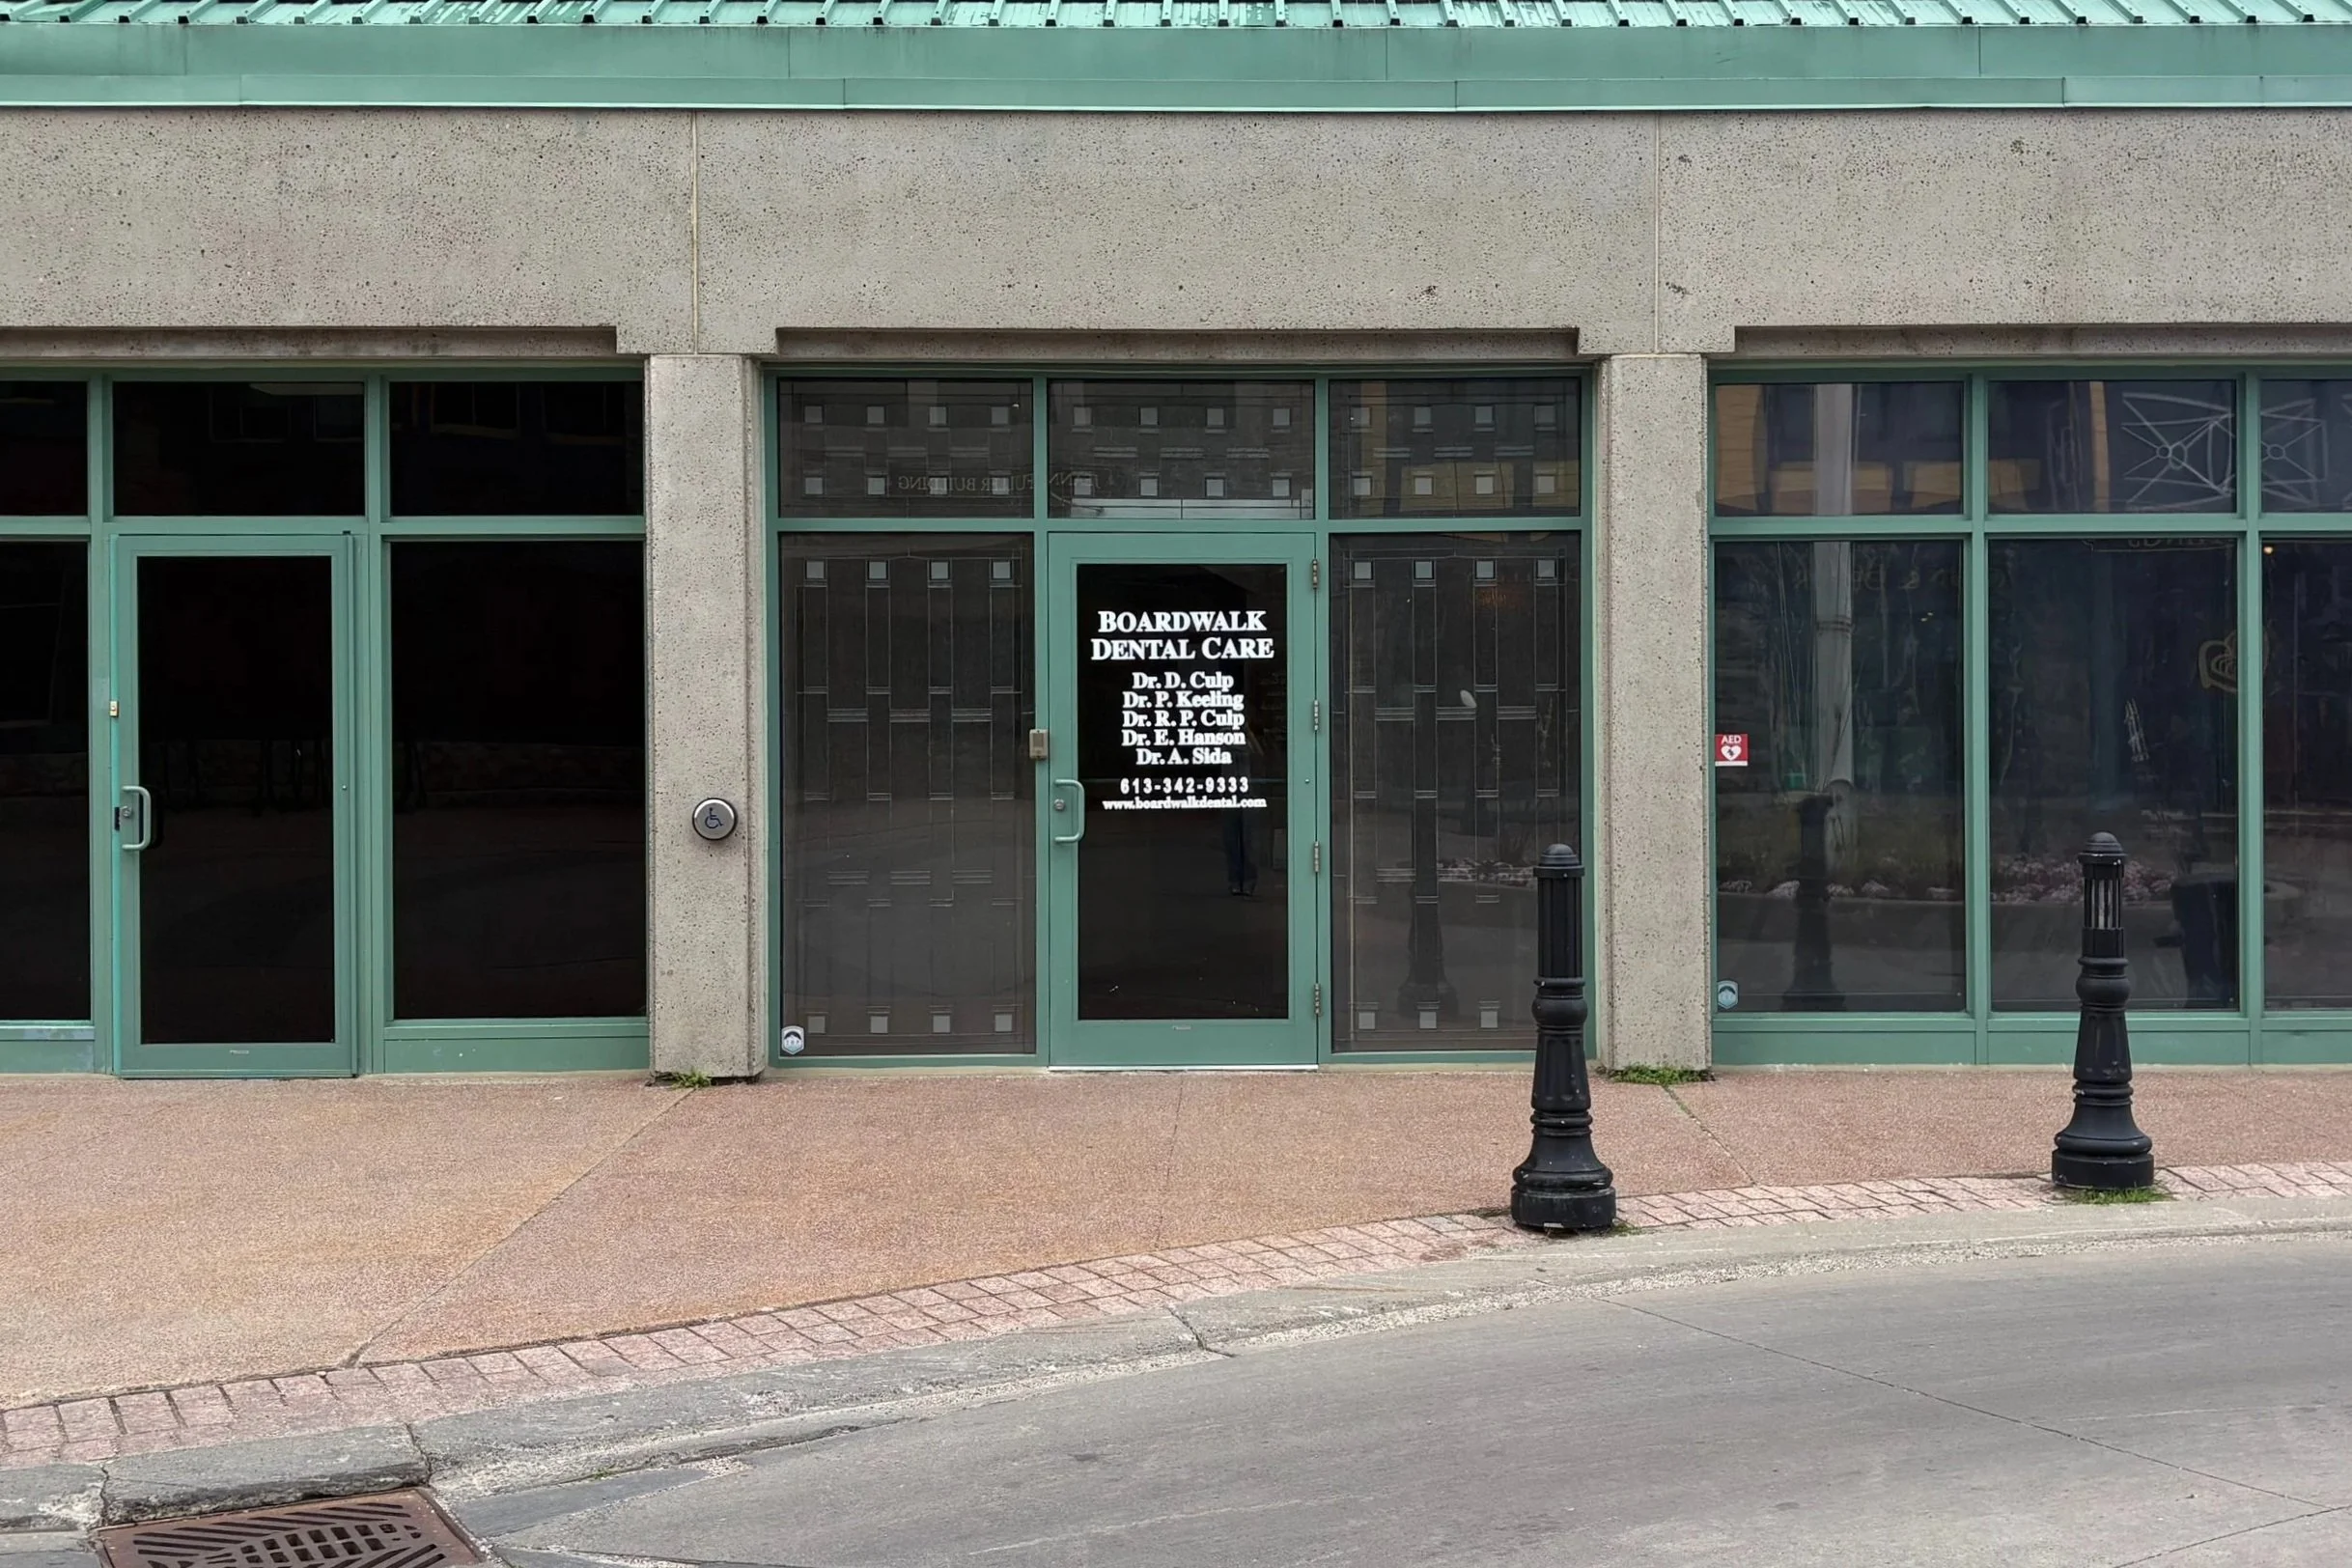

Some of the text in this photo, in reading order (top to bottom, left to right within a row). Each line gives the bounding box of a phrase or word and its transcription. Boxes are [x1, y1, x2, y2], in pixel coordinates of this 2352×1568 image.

[1098, 610, 1268, 633] BOARDWALK
[1090, 636, 1275, 660] DENTAL CARE
[1132, 671, 1235, 691] Dr. D. Culp
[1122, 690, 1245, 711] Dr. P. Keeling
[1122, 710, 1246, 730] Dr. R. P. Culp
[1121, 728, 1246, 747] Dr. E. Hanson
[1721, 734, 1743, 745] AED
[1135, 747, 1233, 765] Dr. A. Sida
[1119, 776, 1250, 795] 613-342-9333
[1102, 795, 1268, 810] www.boardwalkdental.com
